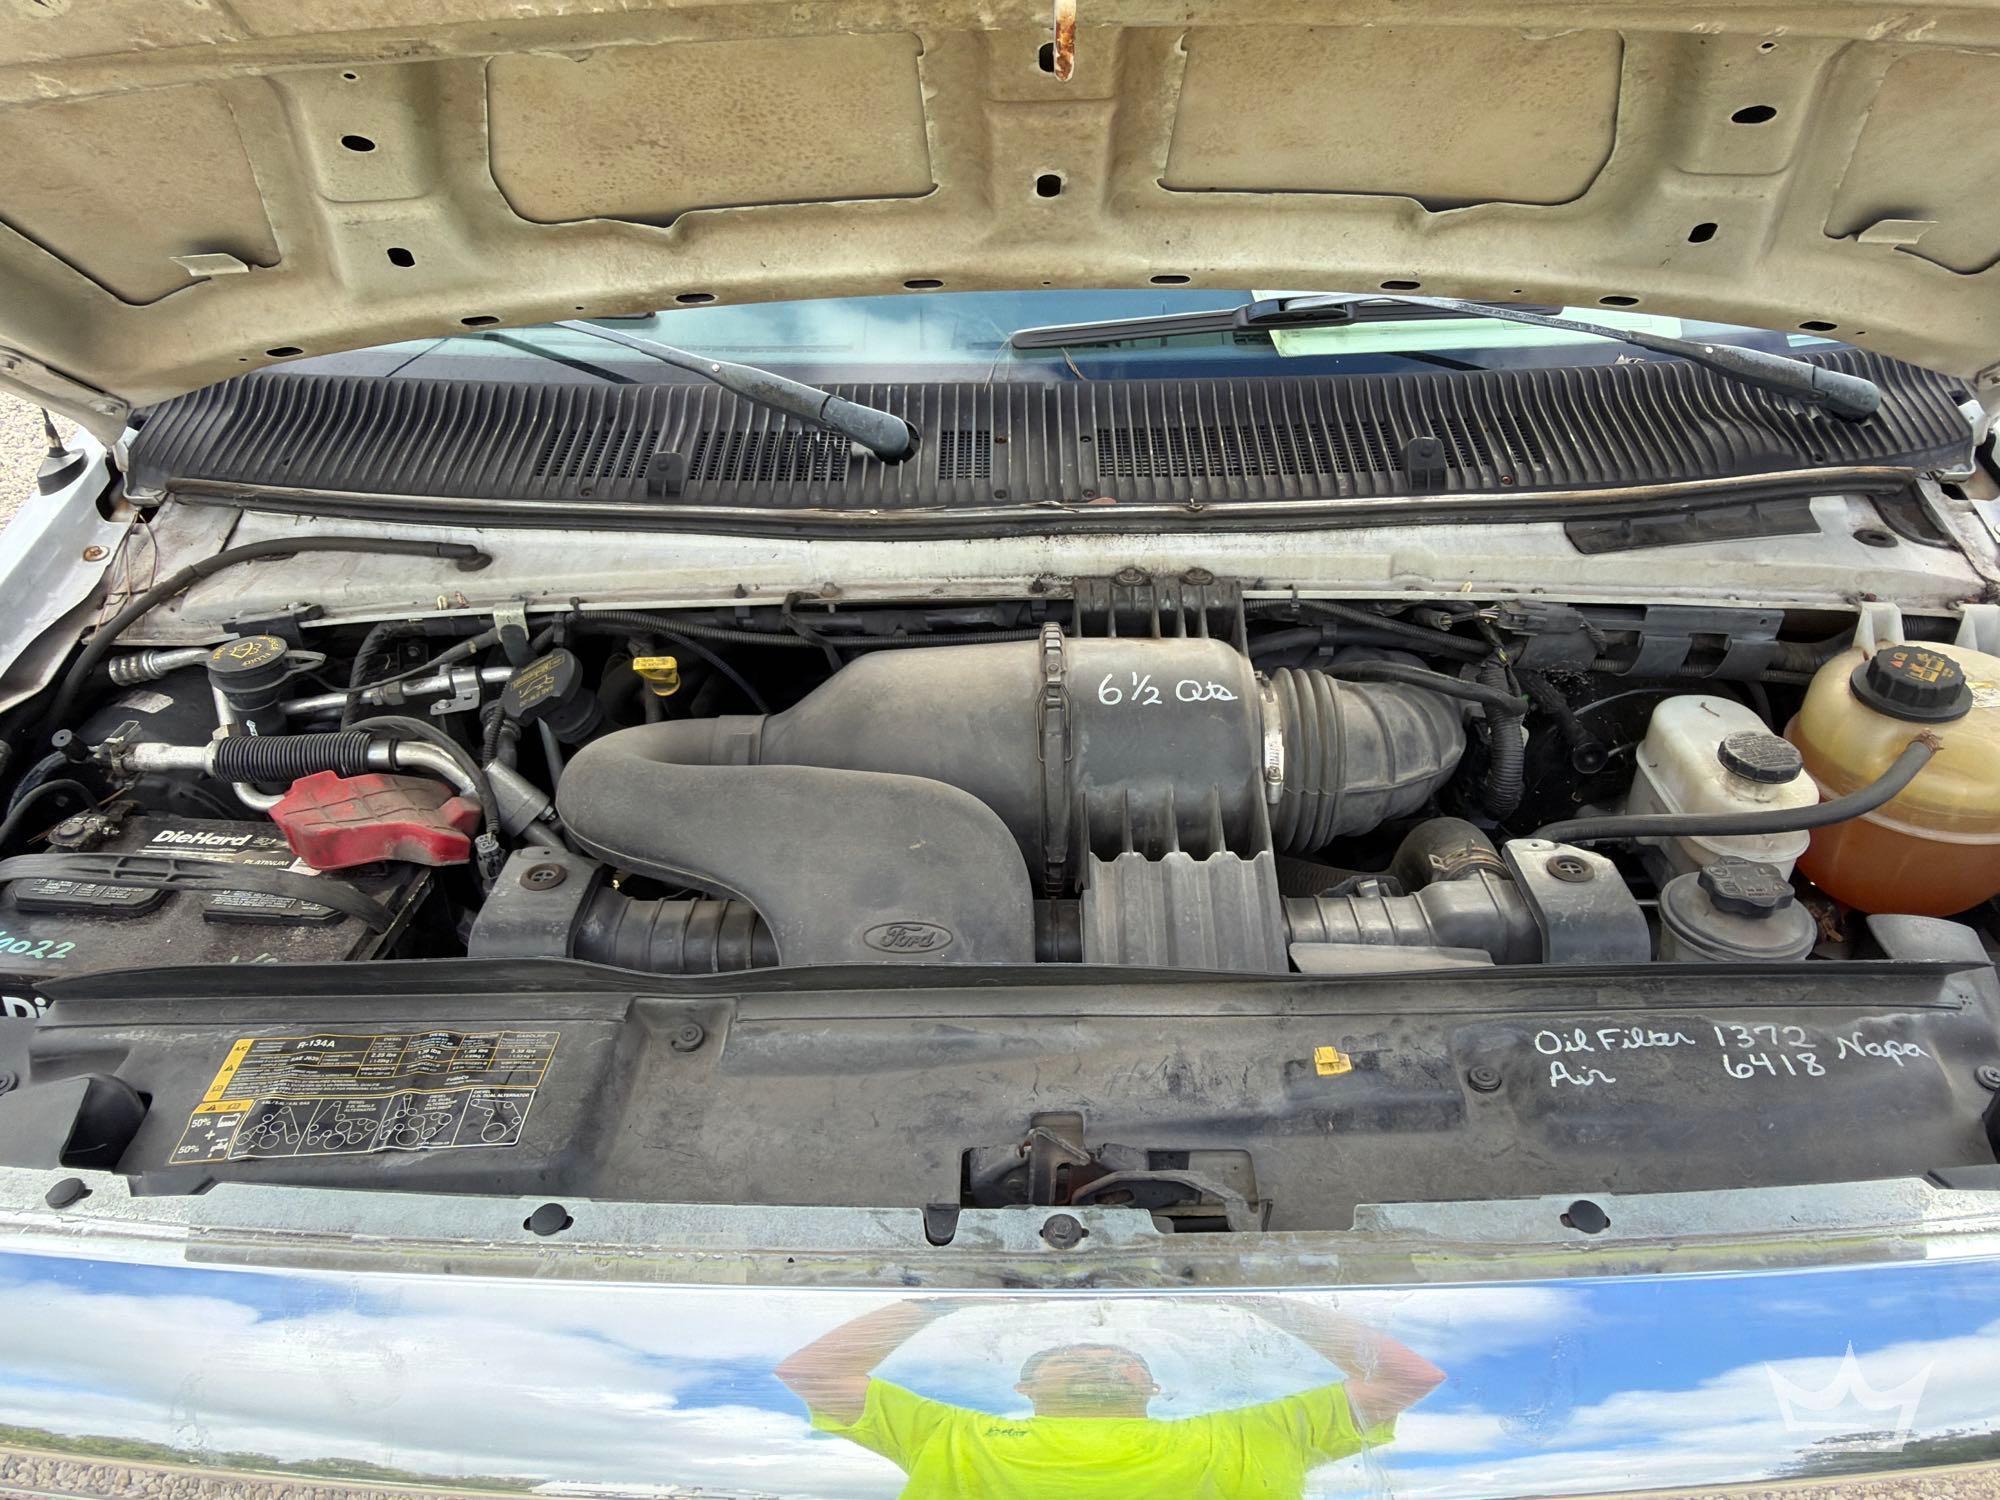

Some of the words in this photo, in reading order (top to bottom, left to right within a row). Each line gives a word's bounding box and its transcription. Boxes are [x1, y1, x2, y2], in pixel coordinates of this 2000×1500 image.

[1098, 673, 1123, 706] 6
[151, 830, 253, 846] DieHard
[243, 859, 290, 867] PLATINUM
[880, 925, 937, 948] Ford
[297, 1039, 336, 1049] R-134A
[1534, 1028, 1595, 1056] Oil
[1597, 1027, 1696, 1051] Filter
[1715, 1025, 1817, 1049] 1372
[1837, 1033, 1932, 1068] Napa
[1550, 1061, 1617, 1088] Air
[1722, 1053, 1826, 1079] 6418
[191, 1118, 212, 1128] 50%
[178, 1145, 200, 1154] 50%
